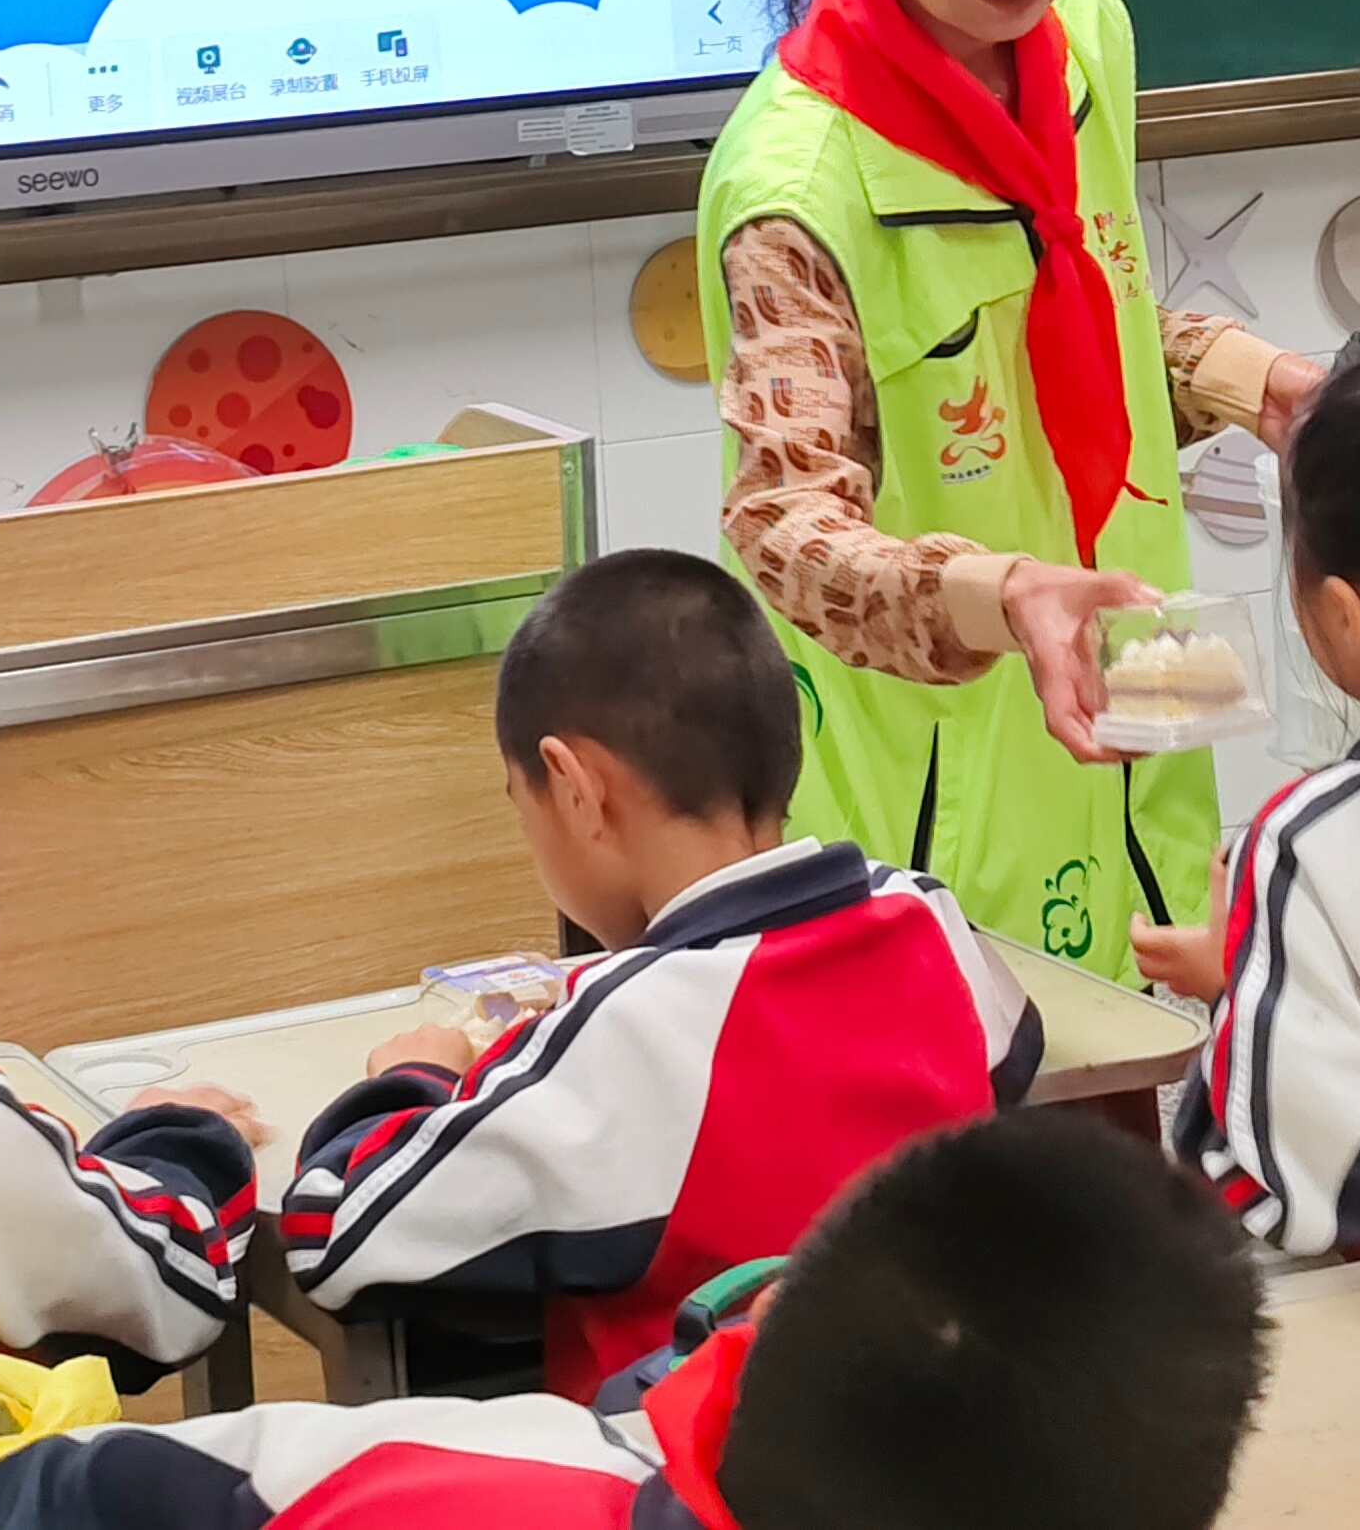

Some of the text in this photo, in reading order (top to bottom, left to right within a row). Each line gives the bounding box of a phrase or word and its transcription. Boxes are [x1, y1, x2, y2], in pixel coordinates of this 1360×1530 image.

[694, 36, 742, 54] 上一页
[360, 65, 429, 86] 手机投屏
[88, 94, 123, 113] 更多
[176, 82, 246, 105] 视频展台
[17, 168, 99, 194] seewo
